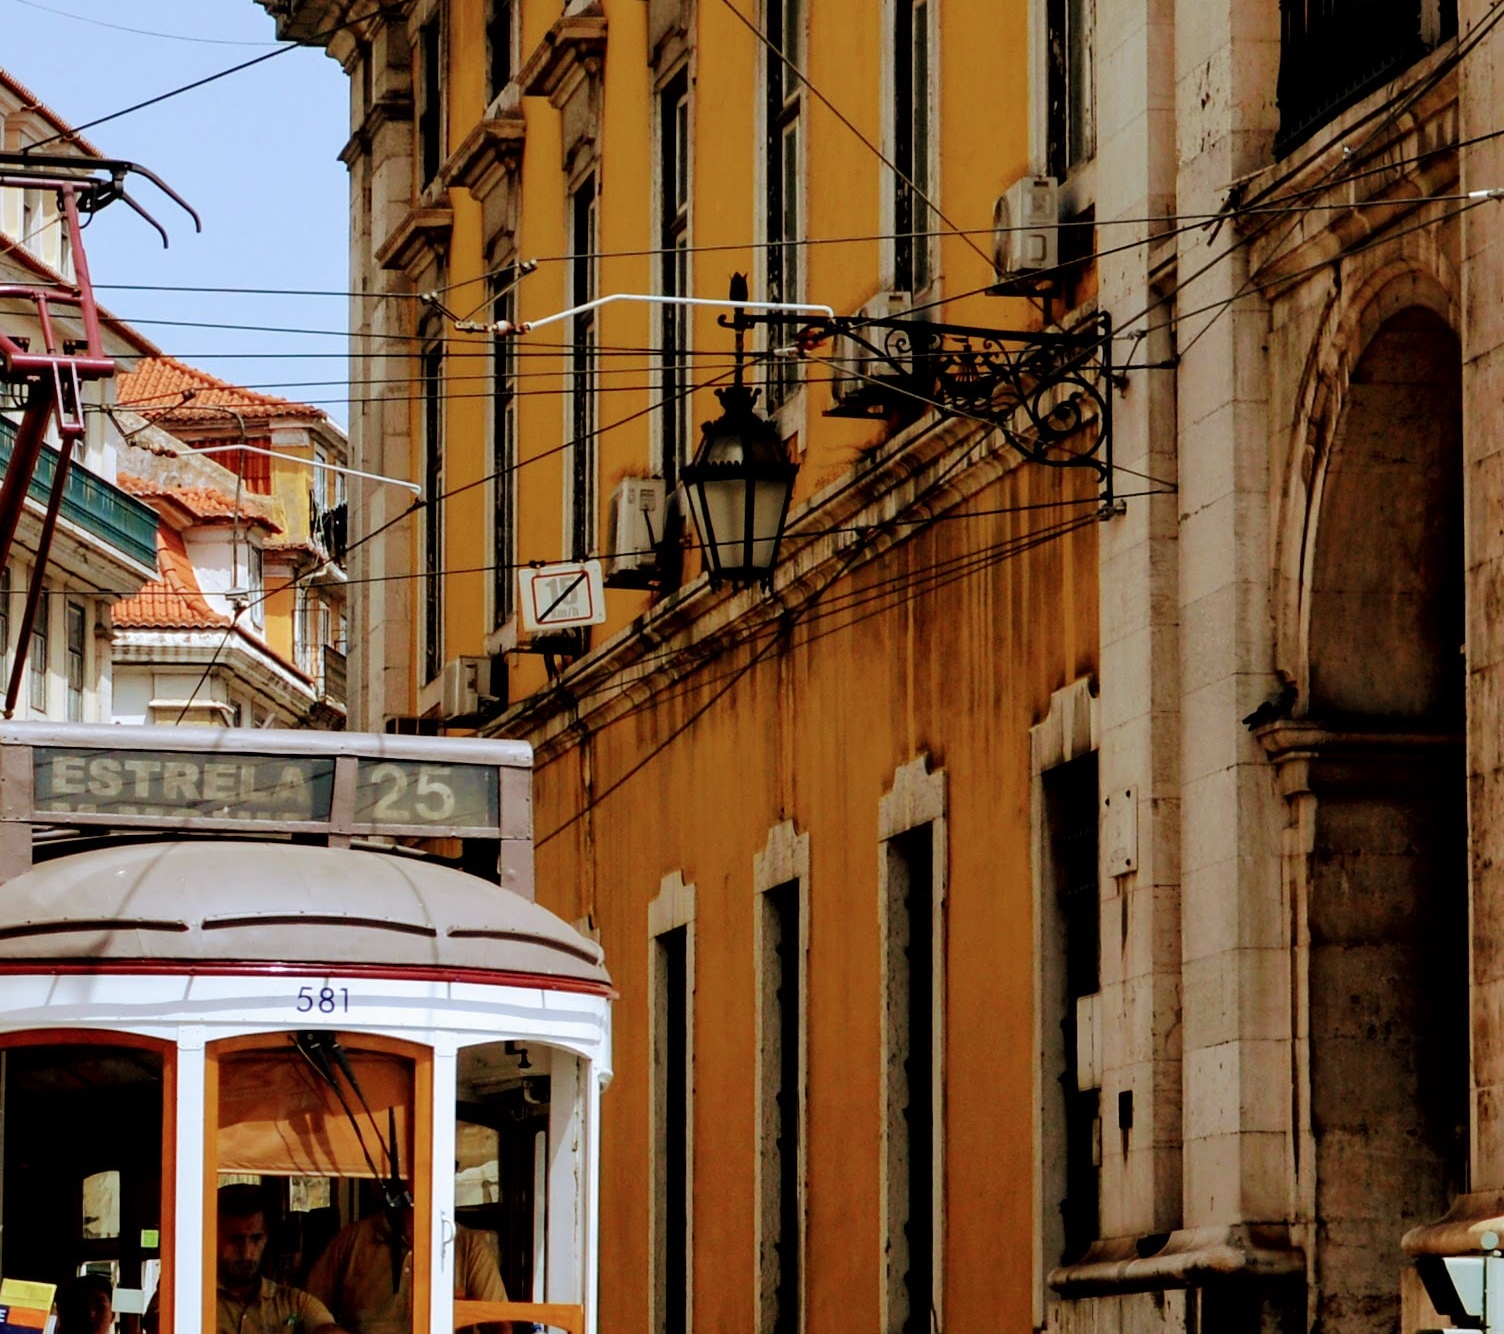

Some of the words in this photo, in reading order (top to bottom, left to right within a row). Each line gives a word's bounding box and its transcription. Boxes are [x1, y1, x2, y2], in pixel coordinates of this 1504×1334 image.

[545, 576, 578, 605] 15
[50, 755, 314, 804] ESTRELA
[369, 765, 455, 821] 25
[296, 986, 348, 1014] 581
